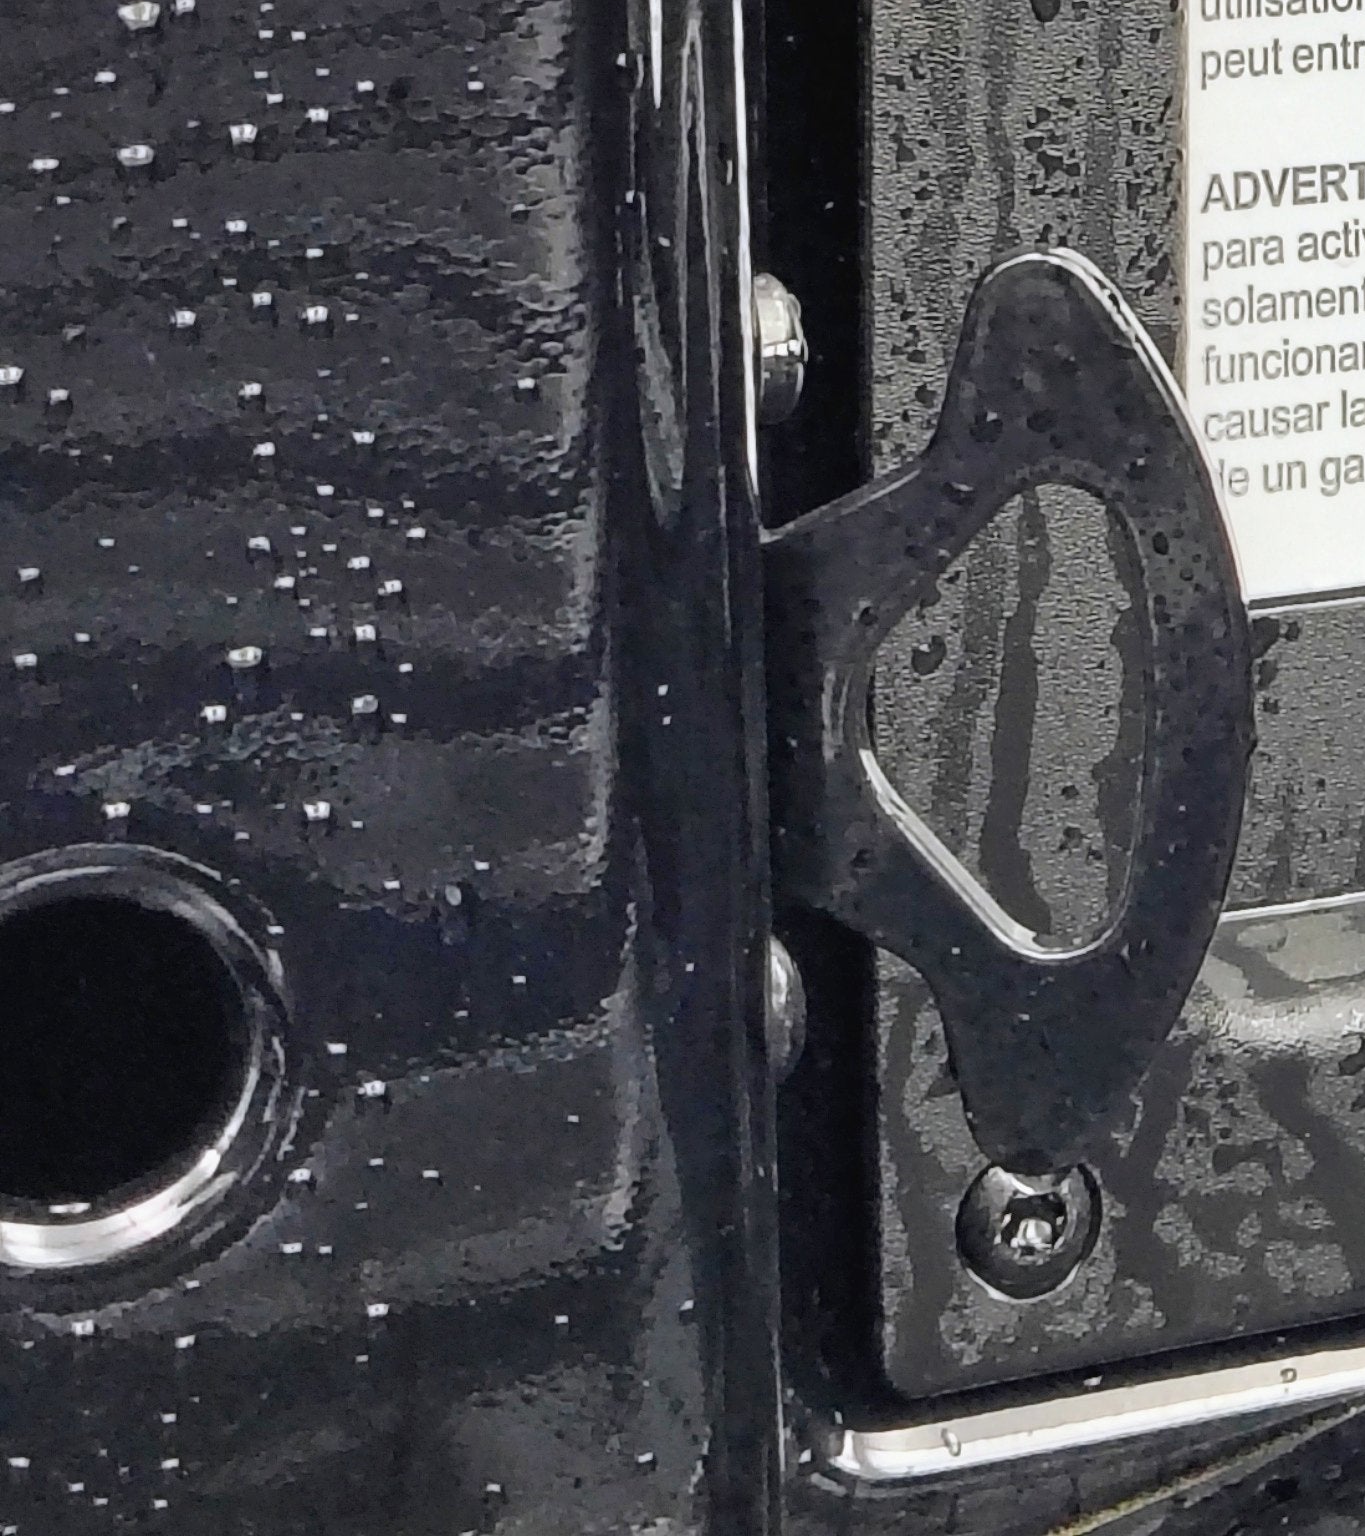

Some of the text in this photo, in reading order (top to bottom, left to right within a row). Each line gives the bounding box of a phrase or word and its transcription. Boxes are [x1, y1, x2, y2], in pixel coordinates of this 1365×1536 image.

[1201, 38, 1282, 90] peut
[1203, 236, 1284, 281] para
[1204, 402, 1330, 441] causar
[1263, 461, 1306, 493] un
